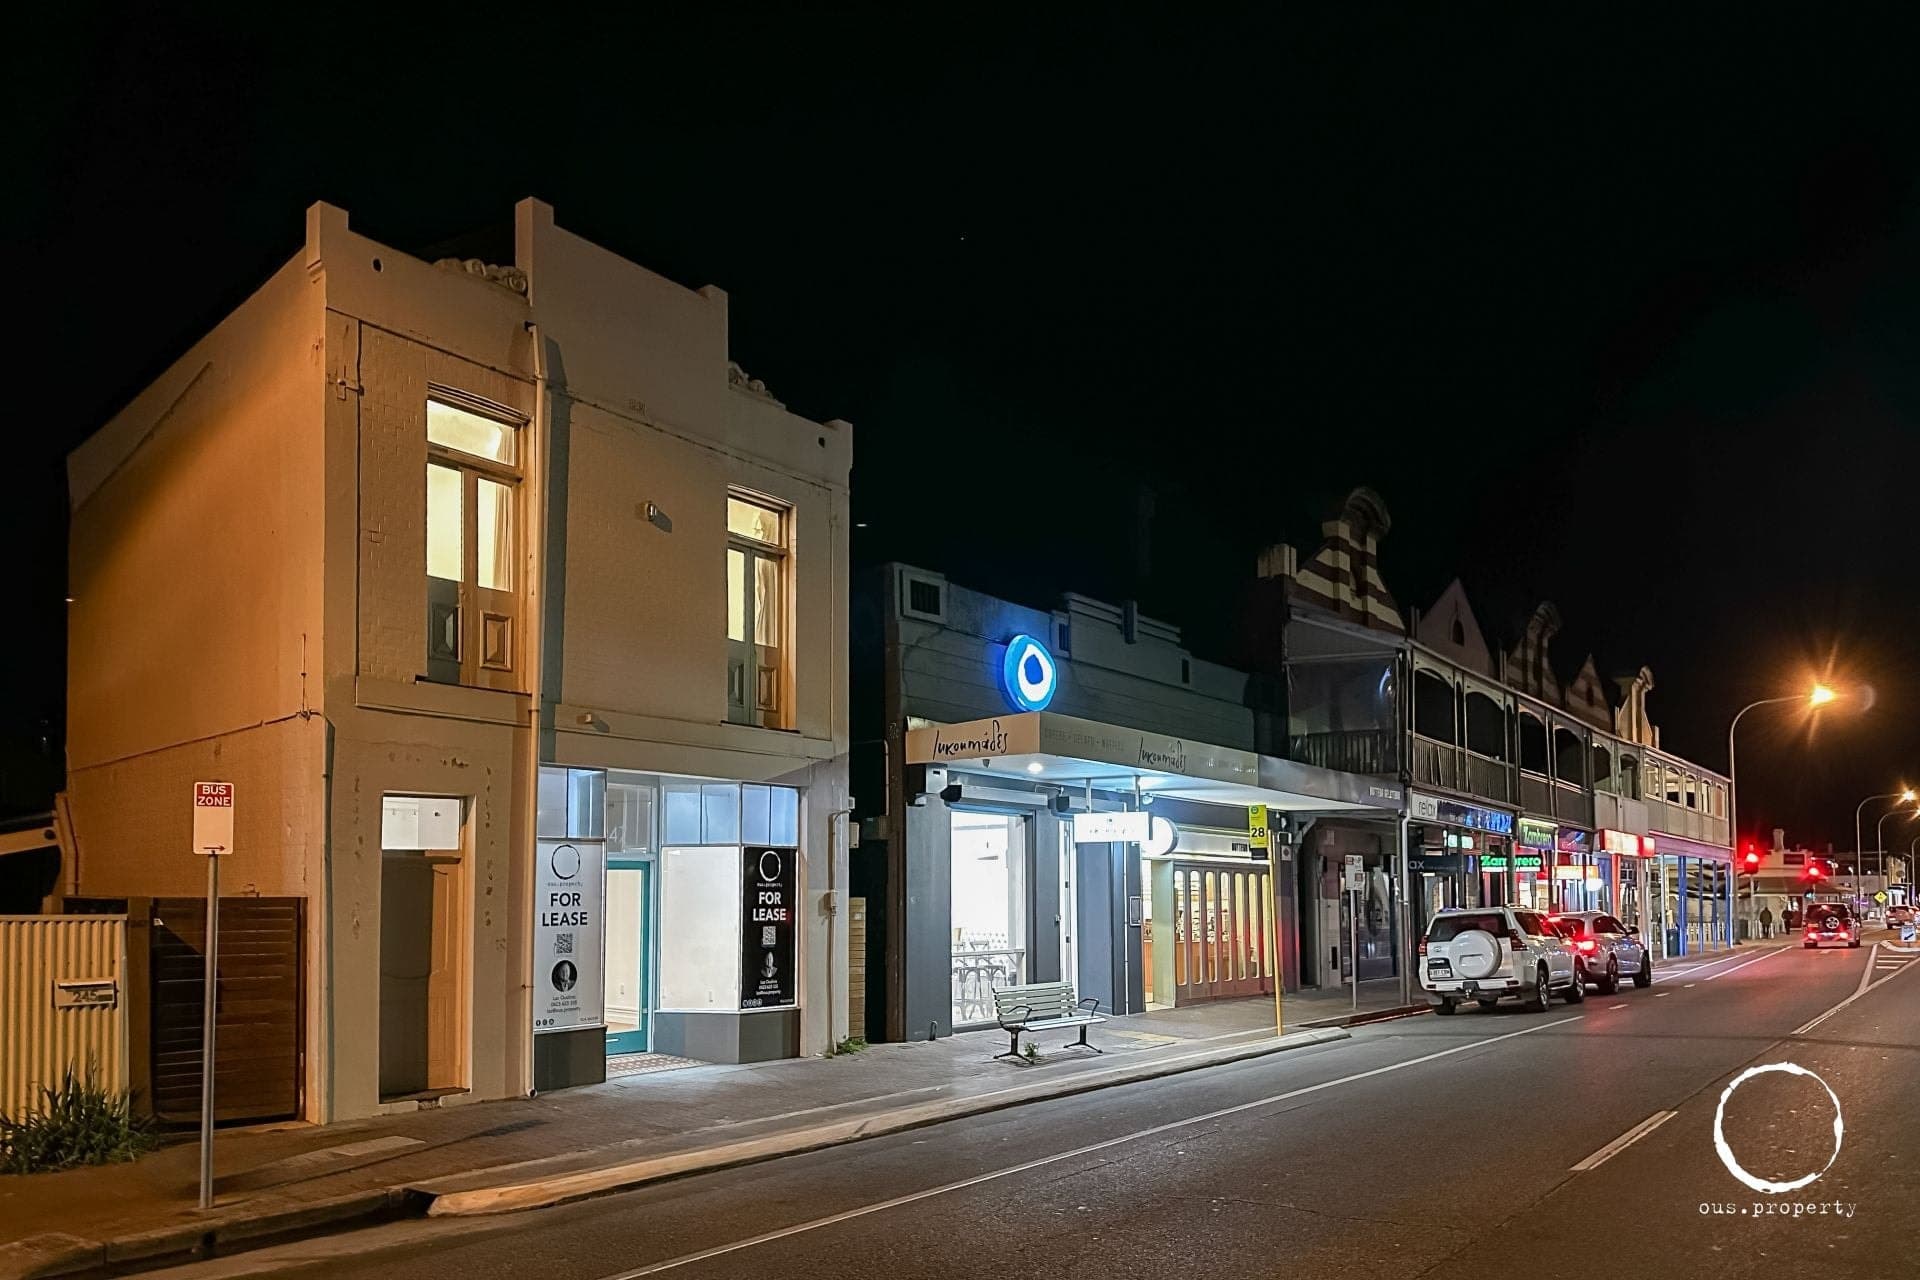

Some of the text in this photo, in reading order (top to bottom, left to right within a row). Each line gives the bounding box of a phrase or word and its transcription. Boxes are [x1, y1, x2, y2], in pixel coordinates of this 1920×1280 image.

[202, 785, 227, 795] BUS
[197, 796, 231, 807] ZONE
[1251, 827, 1265, 838] 28
[1523, 825, 1552, 847] Zambrero
[550, 892, 581, 907] FOR
[758, 891, 782, 905] FOR
[542, 912, 588, 927] LEASE
[752, 908, 787, 921] LEASE
[72, 991, 98, 1003] 245
